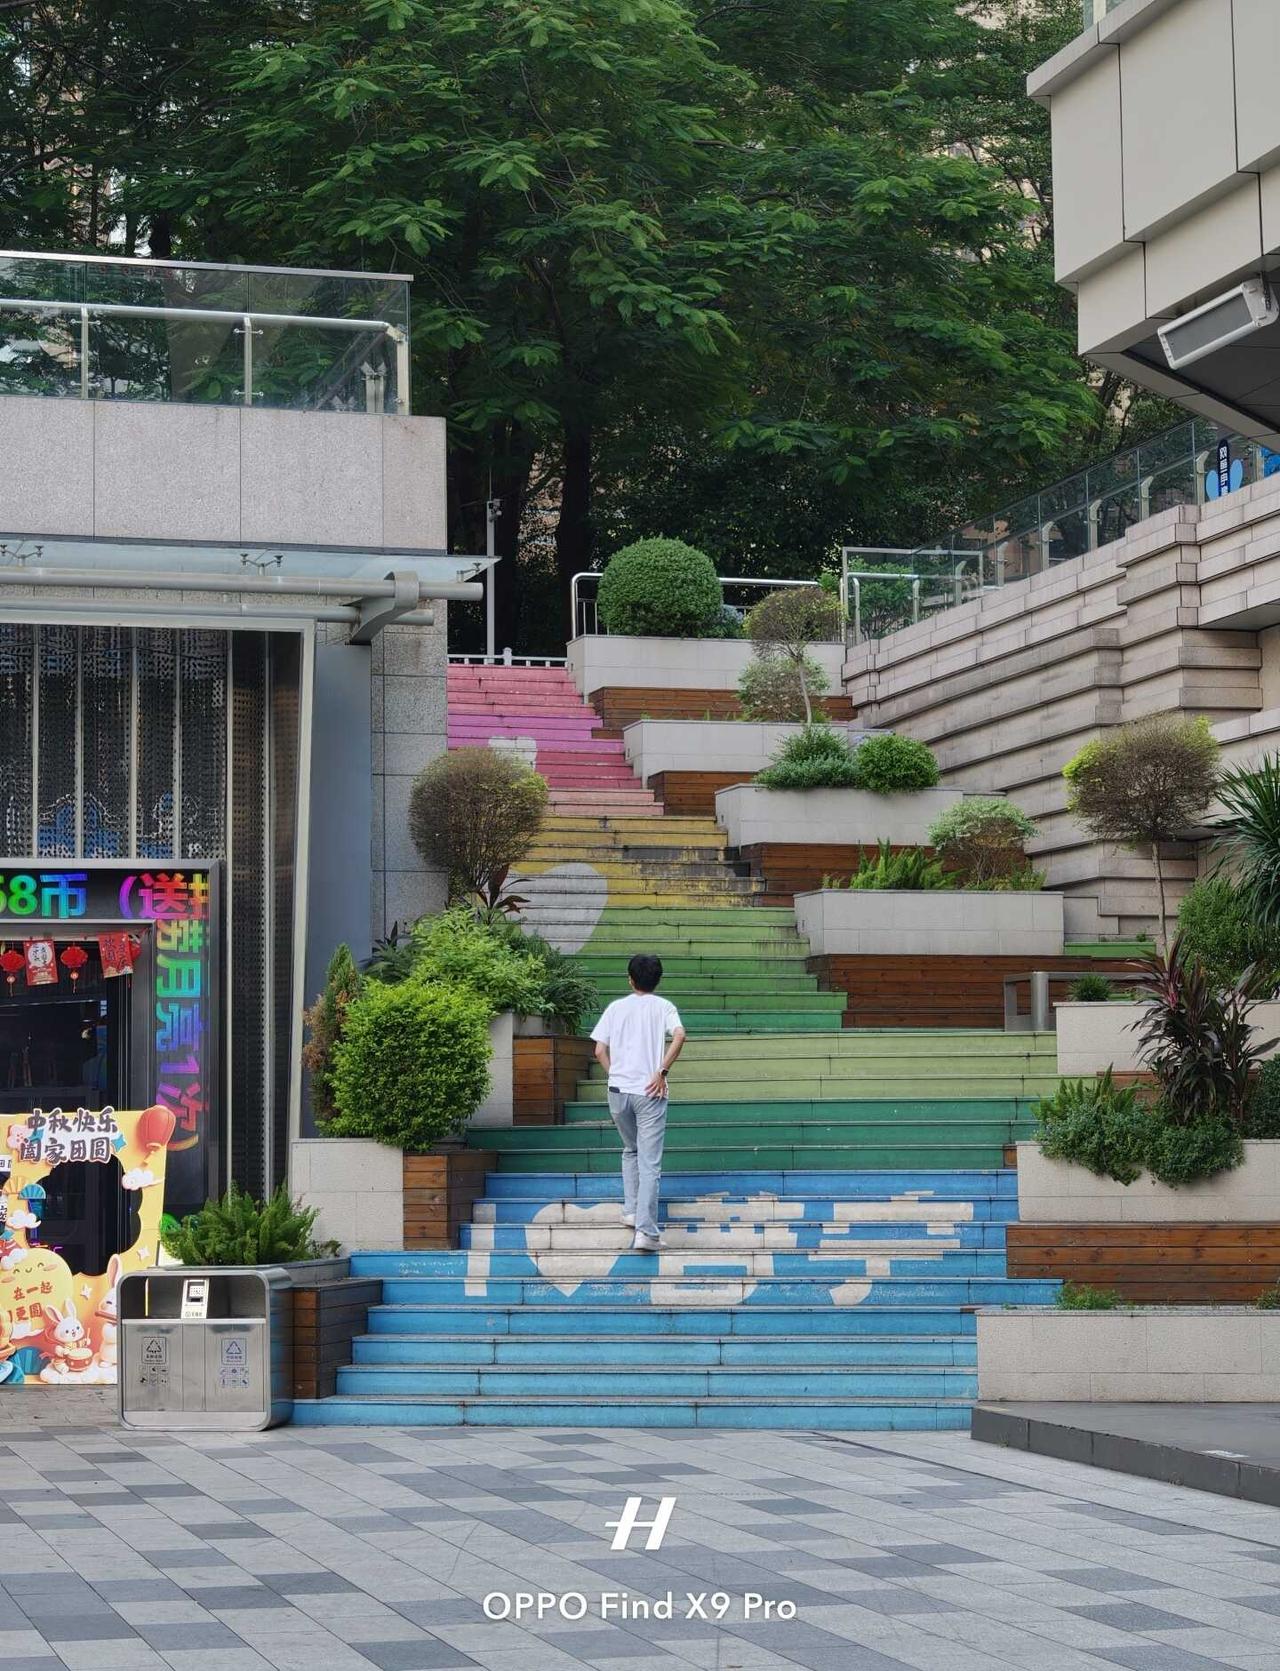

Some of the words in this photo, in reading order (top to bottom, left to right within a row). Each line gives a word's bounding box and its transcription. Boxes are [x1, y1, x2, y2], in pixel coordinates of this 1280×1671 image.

[28, 1107, 118, 1134] 中秋快乐
[21, 1137, 110, 1163] 阖家团圆
[13, 1281, 53, 1301] 在一起
[8, 1302, 42, 1323] 更圆
